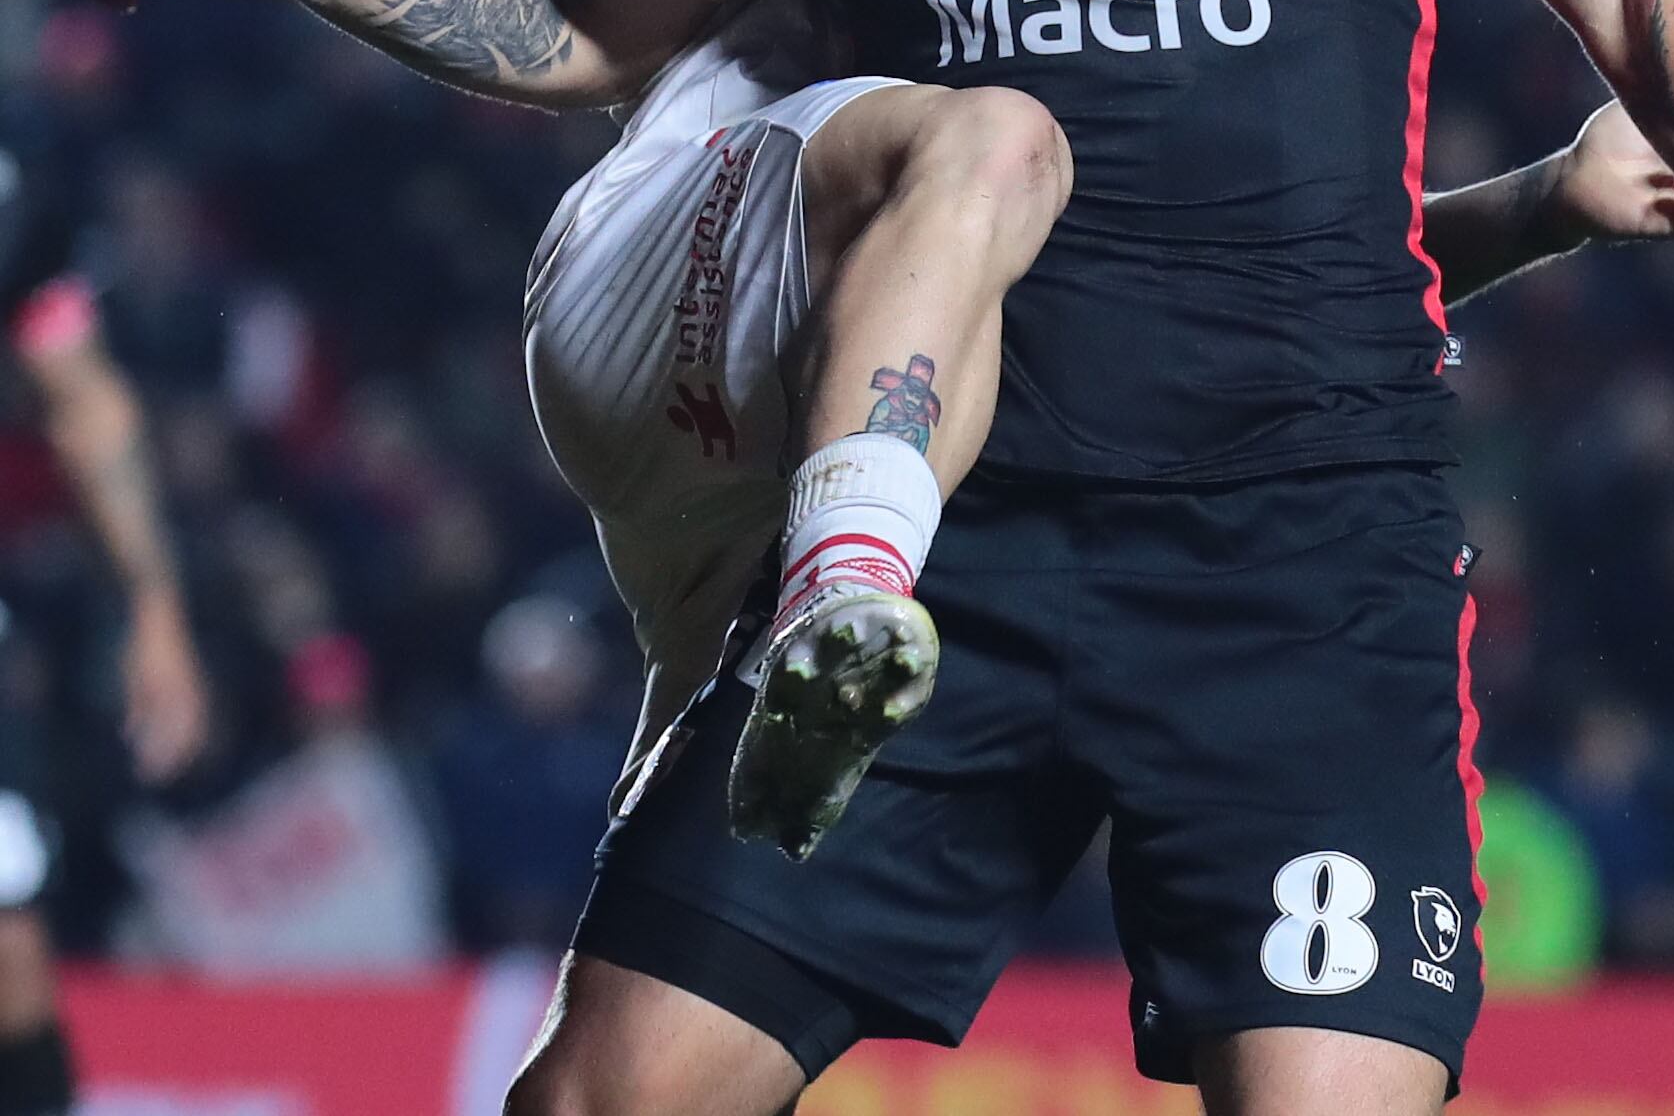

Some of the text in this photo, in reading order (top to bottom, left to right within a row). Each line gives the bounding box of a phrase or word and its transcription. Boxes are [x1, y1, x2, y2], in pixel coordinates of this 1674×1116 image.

[1260, 850, 1380, 995] 8
[1331, 965, 1358, 977] LYON
[1413, 960, 1455, 992] LYON
